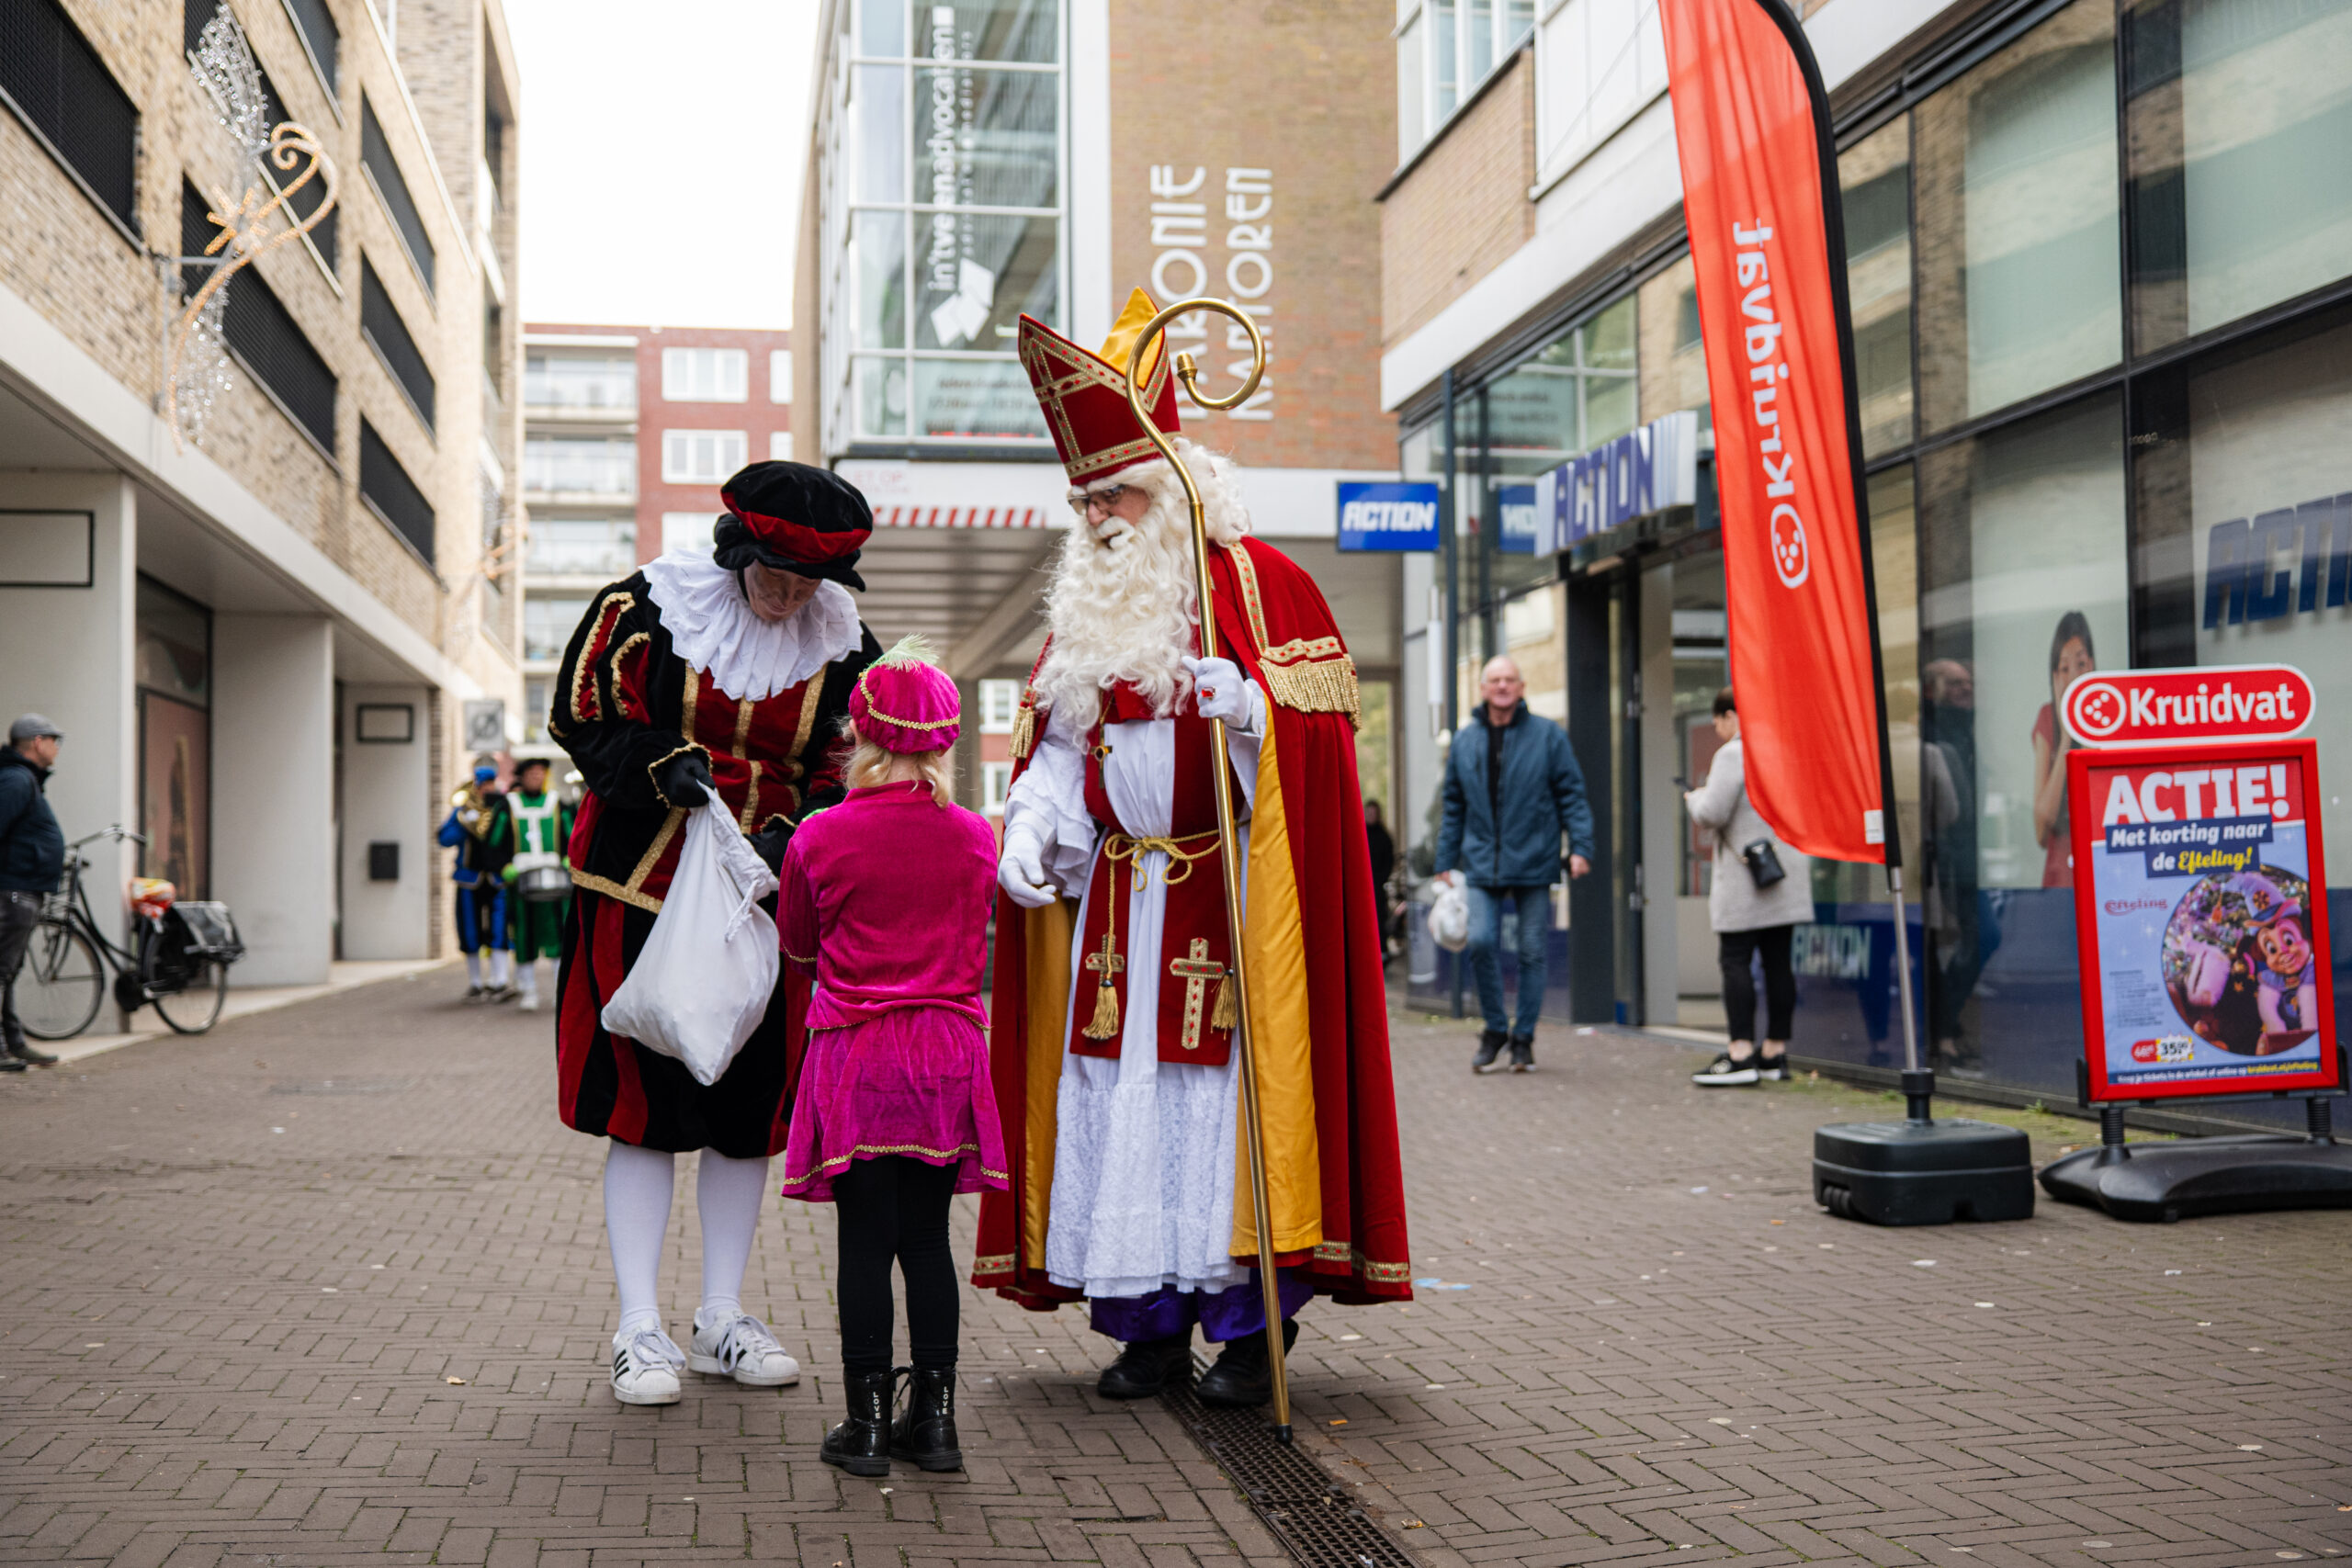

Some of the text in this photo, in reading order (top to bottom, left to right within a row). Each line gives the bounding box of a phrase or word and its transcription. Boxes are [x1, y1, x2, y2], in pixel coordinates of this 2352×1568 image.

[1553, 422, 1658, 549] ACTION
[1342, 501, 1436, 532] ACTION
[2203, 491, 2352, 631] ACTI
[2129, 682, 2296, 728] Kruidvat
[2102, 764, 2290, 827] ACTIE!
[2111, 822, 2267, 848] Met korting naar
[2152, 847, 2254, 874] de Efteling!
[873, 1392, 881, 1419] LOVE
